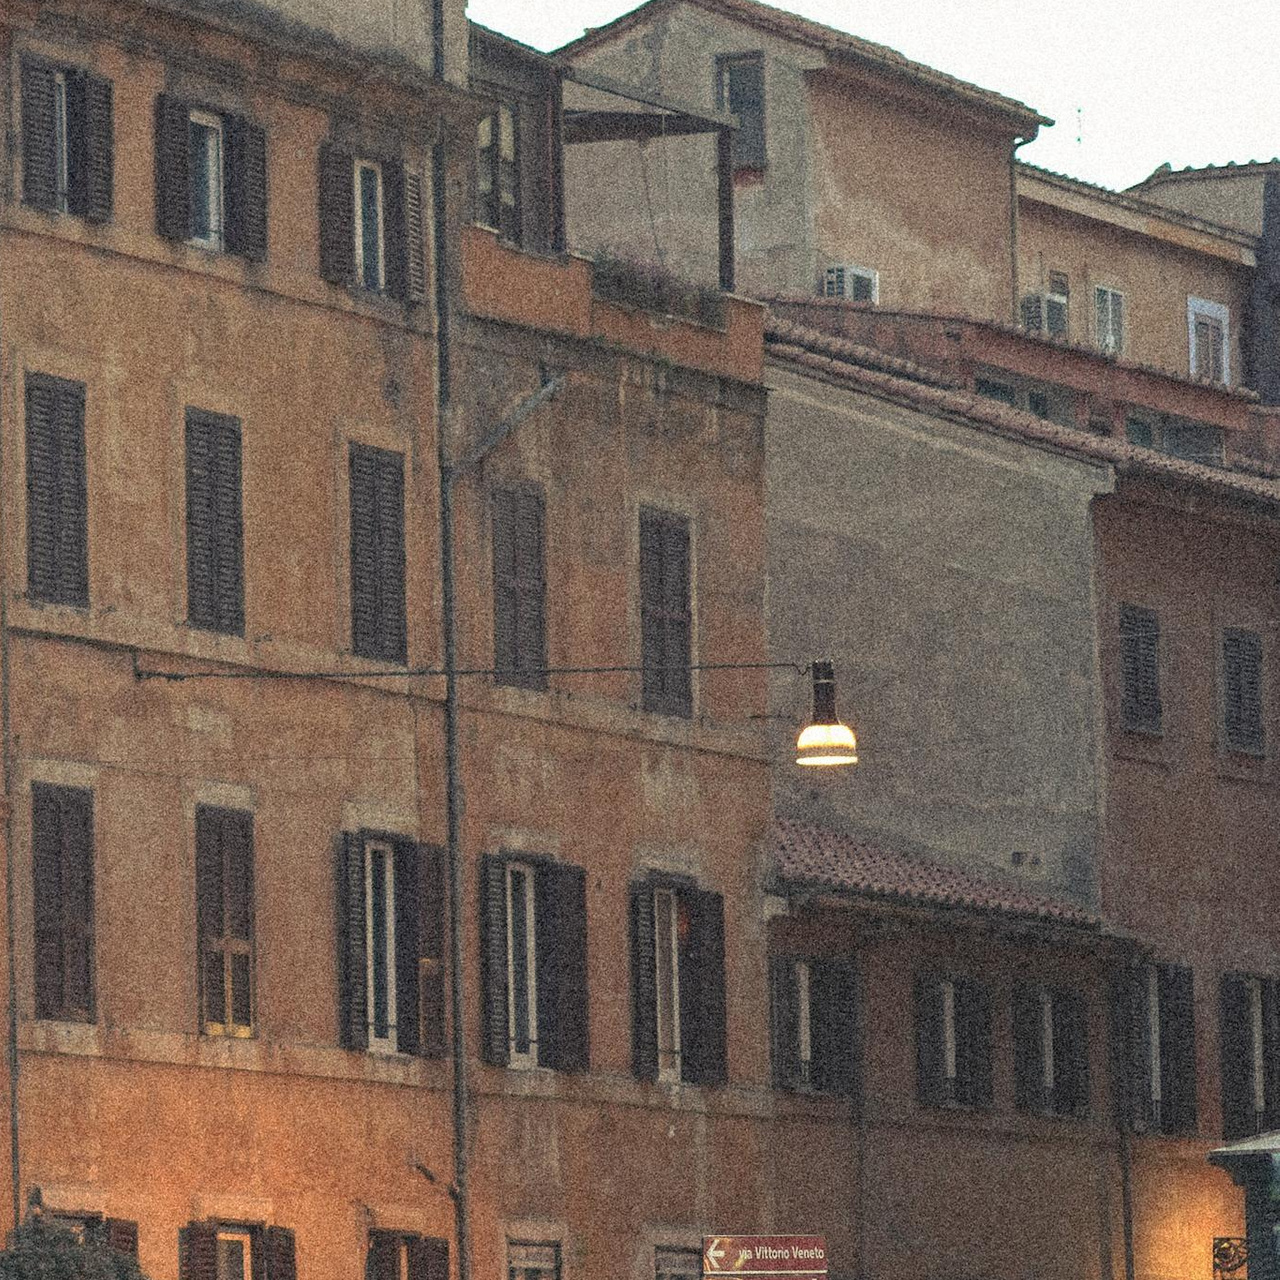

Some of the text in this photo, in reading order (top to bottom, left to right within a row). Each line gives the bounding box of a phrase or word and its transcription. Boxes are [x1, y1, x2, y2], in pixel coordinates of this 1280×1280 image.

[738, 1246, 825, 1259] via Vittorio Veneto
